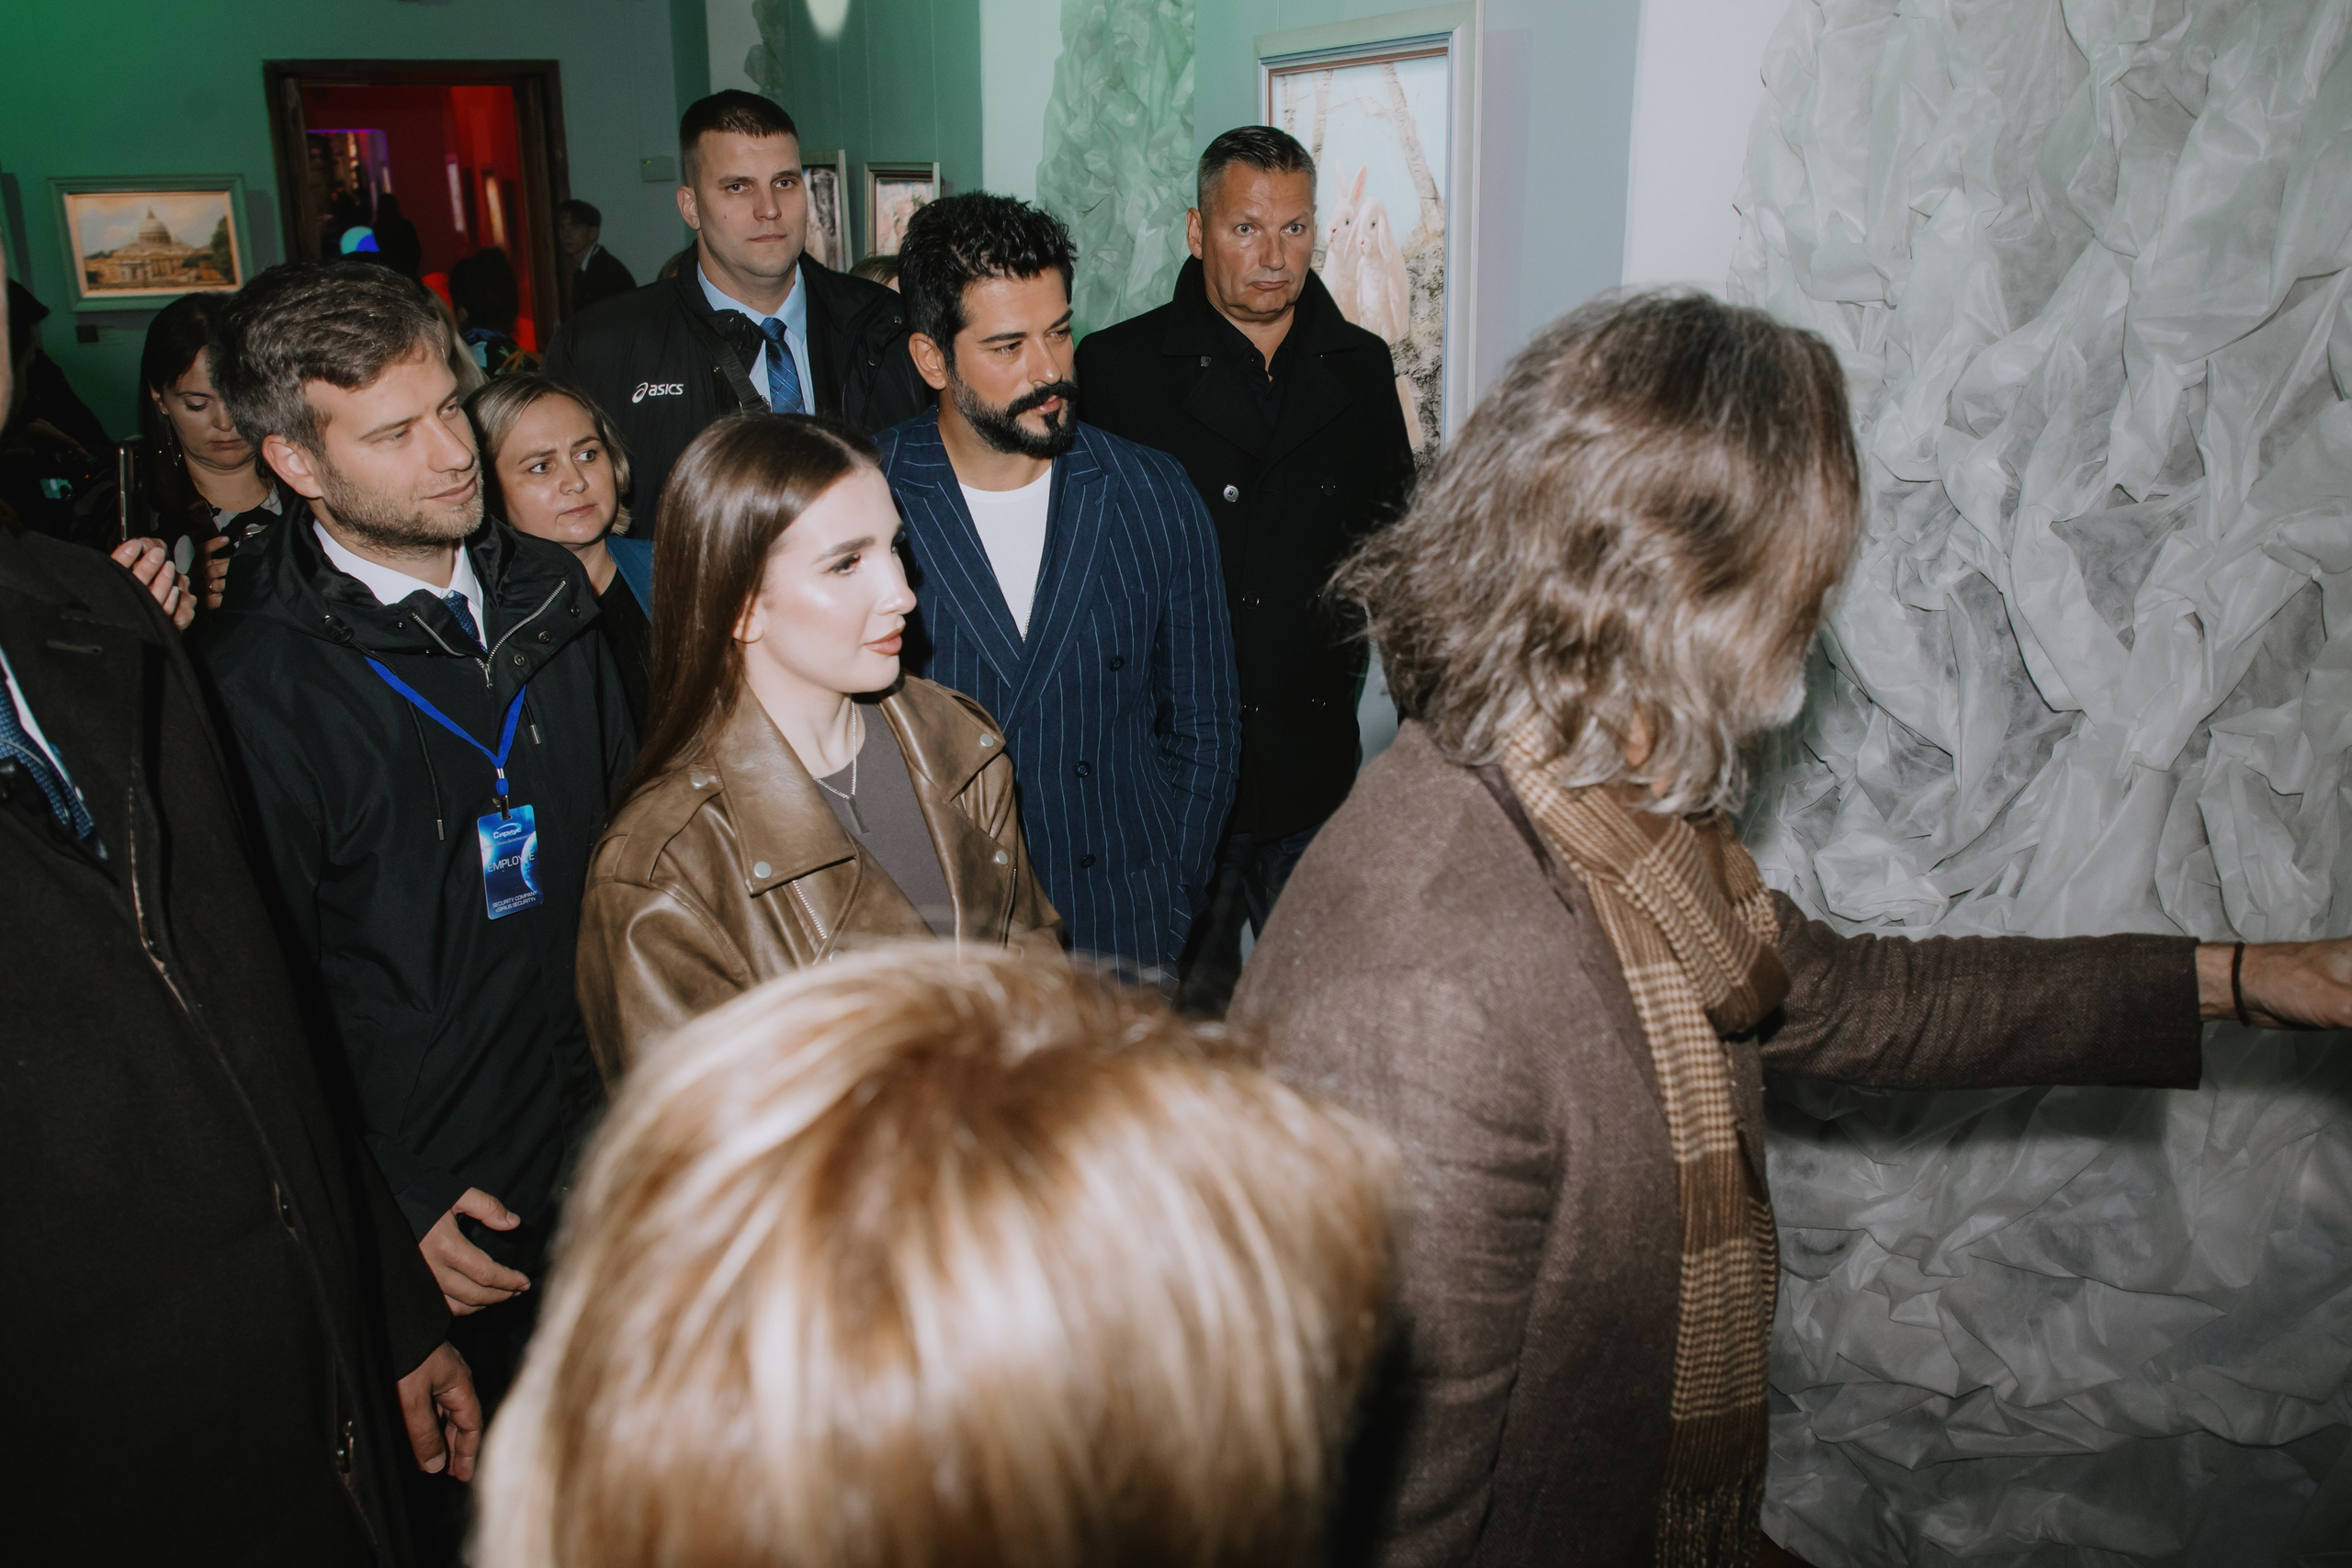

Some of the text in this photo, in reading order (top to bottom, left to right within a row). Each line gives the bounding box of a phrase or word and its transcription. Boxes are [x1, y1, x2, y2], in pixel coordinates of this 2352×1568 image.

[649, 383, 684, 397] asics
[492, 828, 522, 840] Сириус
[492, 890, 537, 908] SECURITY COMPANY
